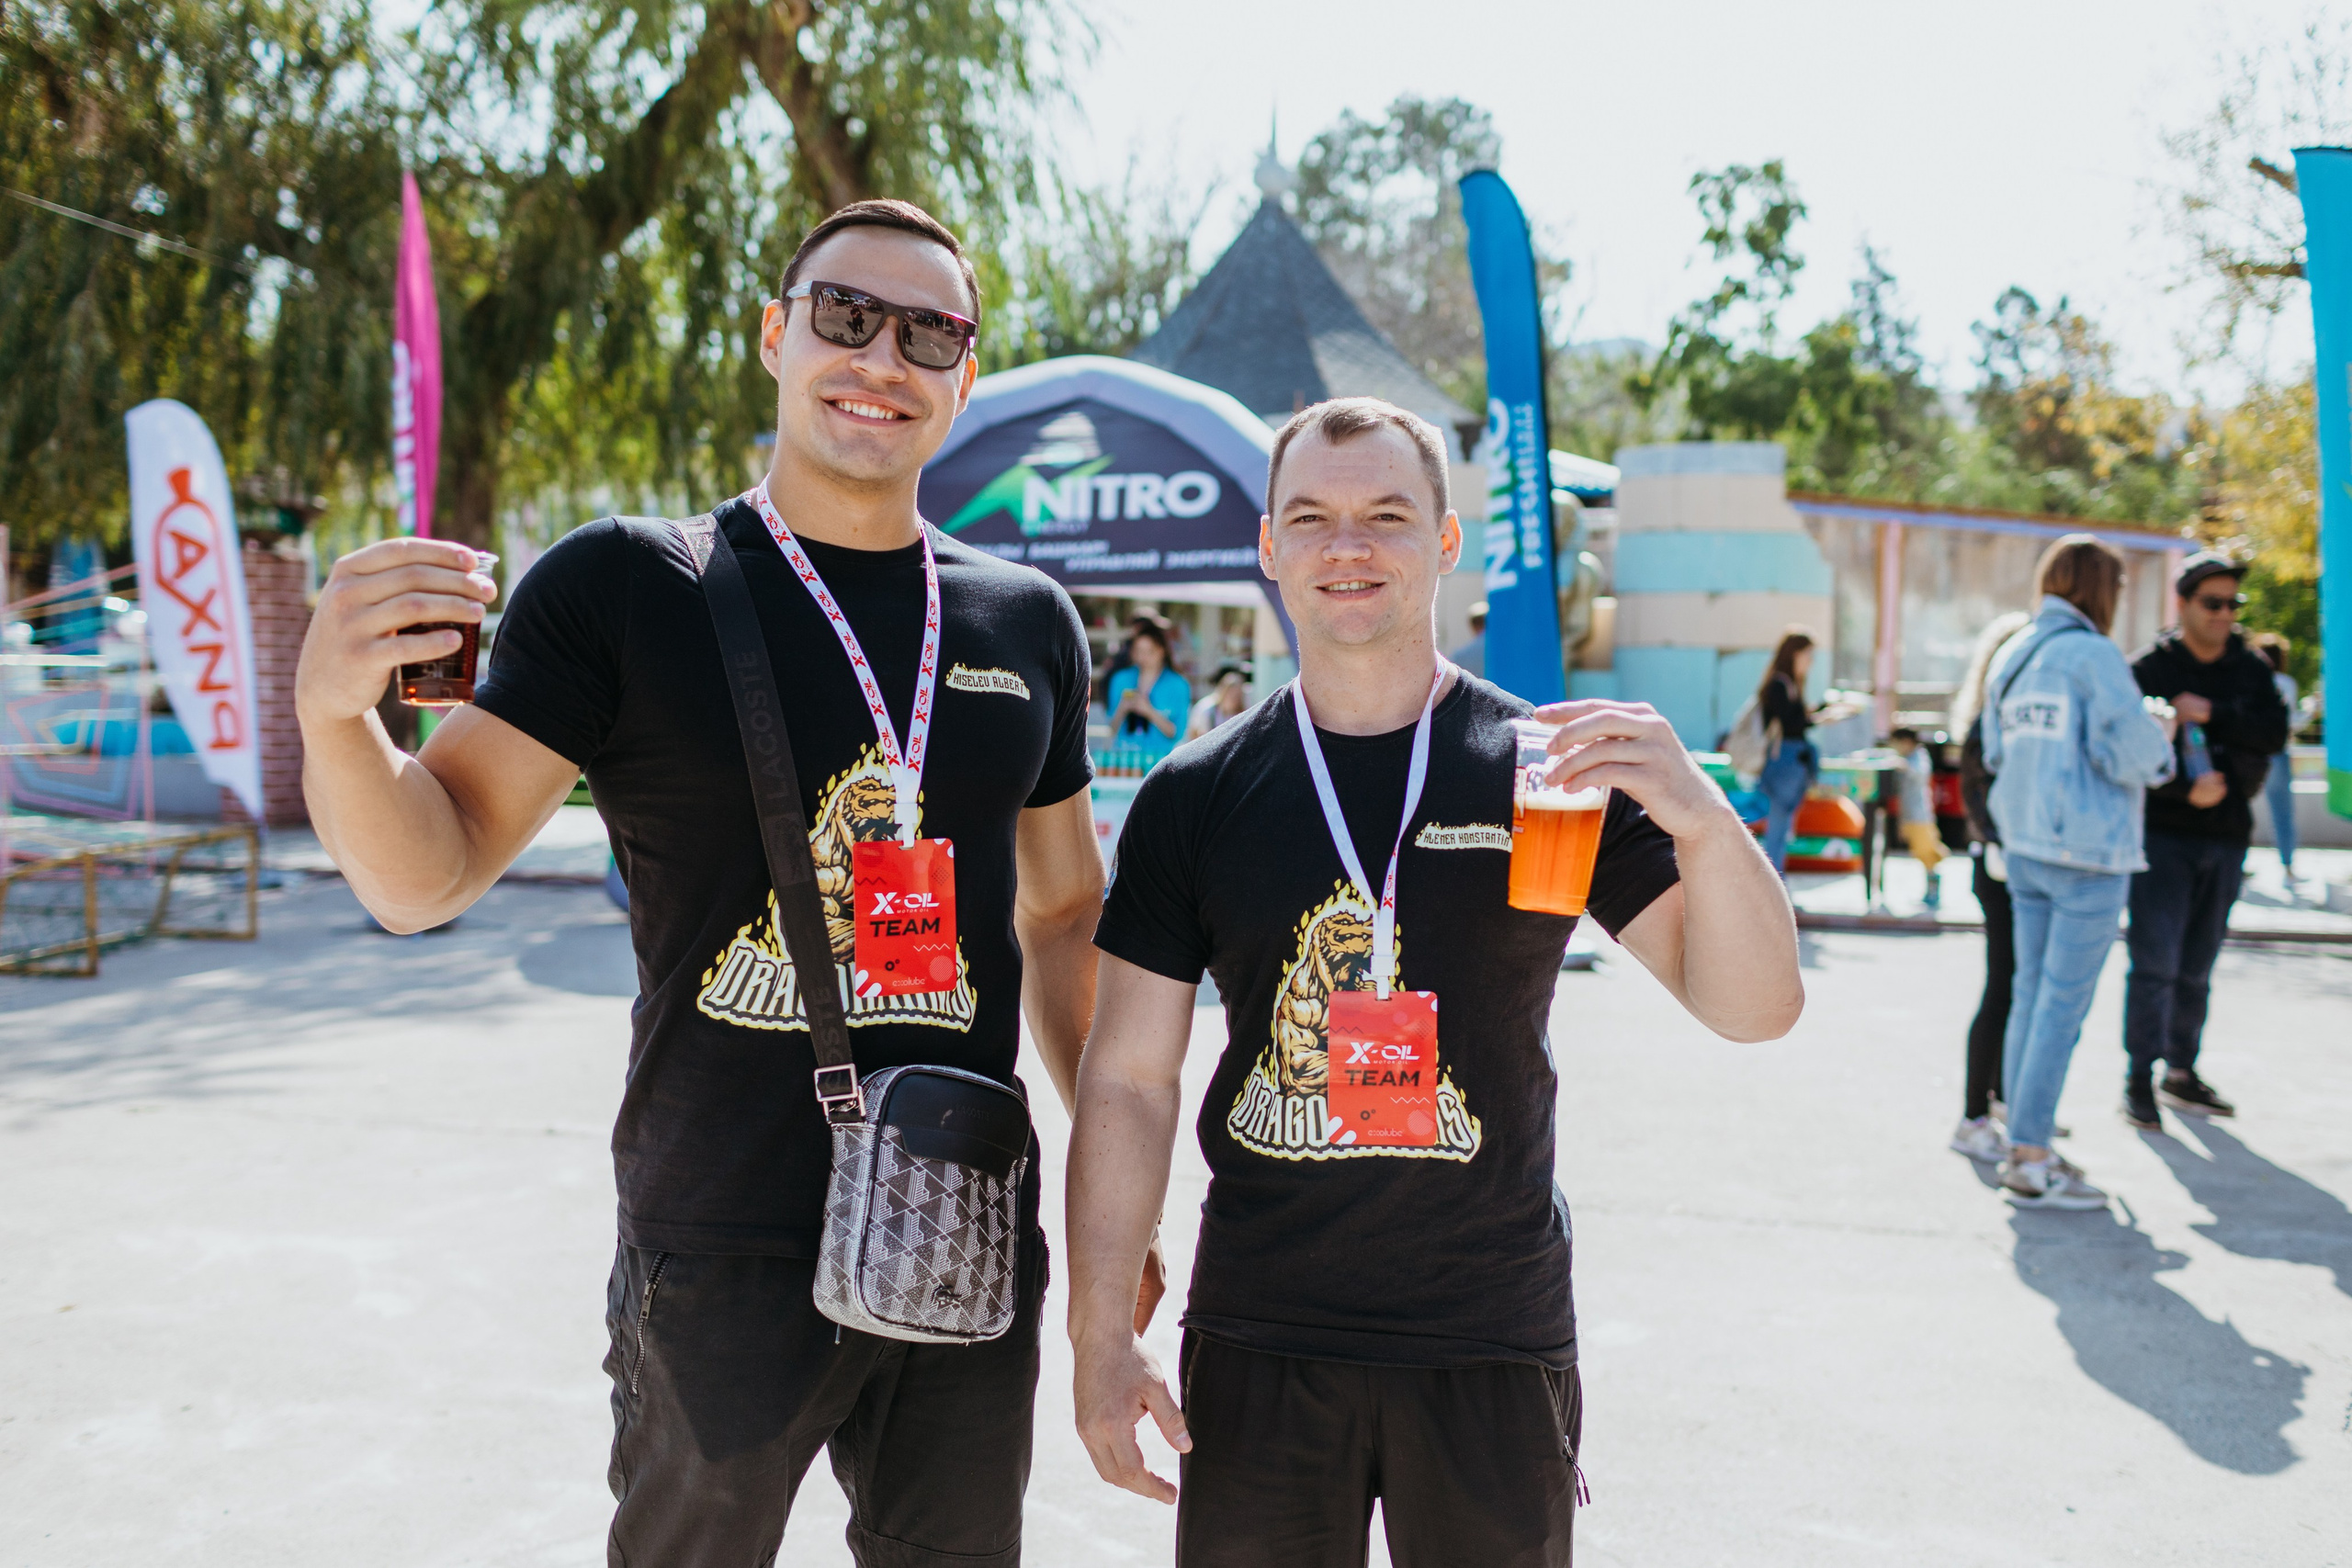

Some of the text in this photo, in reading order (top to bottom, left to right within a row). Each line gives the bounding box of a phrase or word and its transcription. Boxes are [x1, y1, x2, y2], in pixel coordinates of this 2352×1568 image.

[1023, 470, 1221, 521] NITRO
[790, 550, 818, 583] X-OIL
[817, 590, 843, 623] X-OIL
[843, 631, 866, 667] X-OIL
[922, 641, 933, 678] X-OIL
[864, 678, 885, 716] X-OIL
[992, 676, 1024, 694] ALBERT
[915, 686, 928, 724] X-OIL
[736, 651, 788, 799] LACOSTE
[881, 727, 900, 766] X-OIL
[908, 734, 922, 773] X-OIL
[1458, 831, 1510, 847] KONSTANTIN
[870, 892, 940, 915] X-OIL
[870, 917, 941, 937] TEAM
[1345, 1042, 1420, 1065] X-OIL
[1344, 1069, 1420, 1087] TEAM
